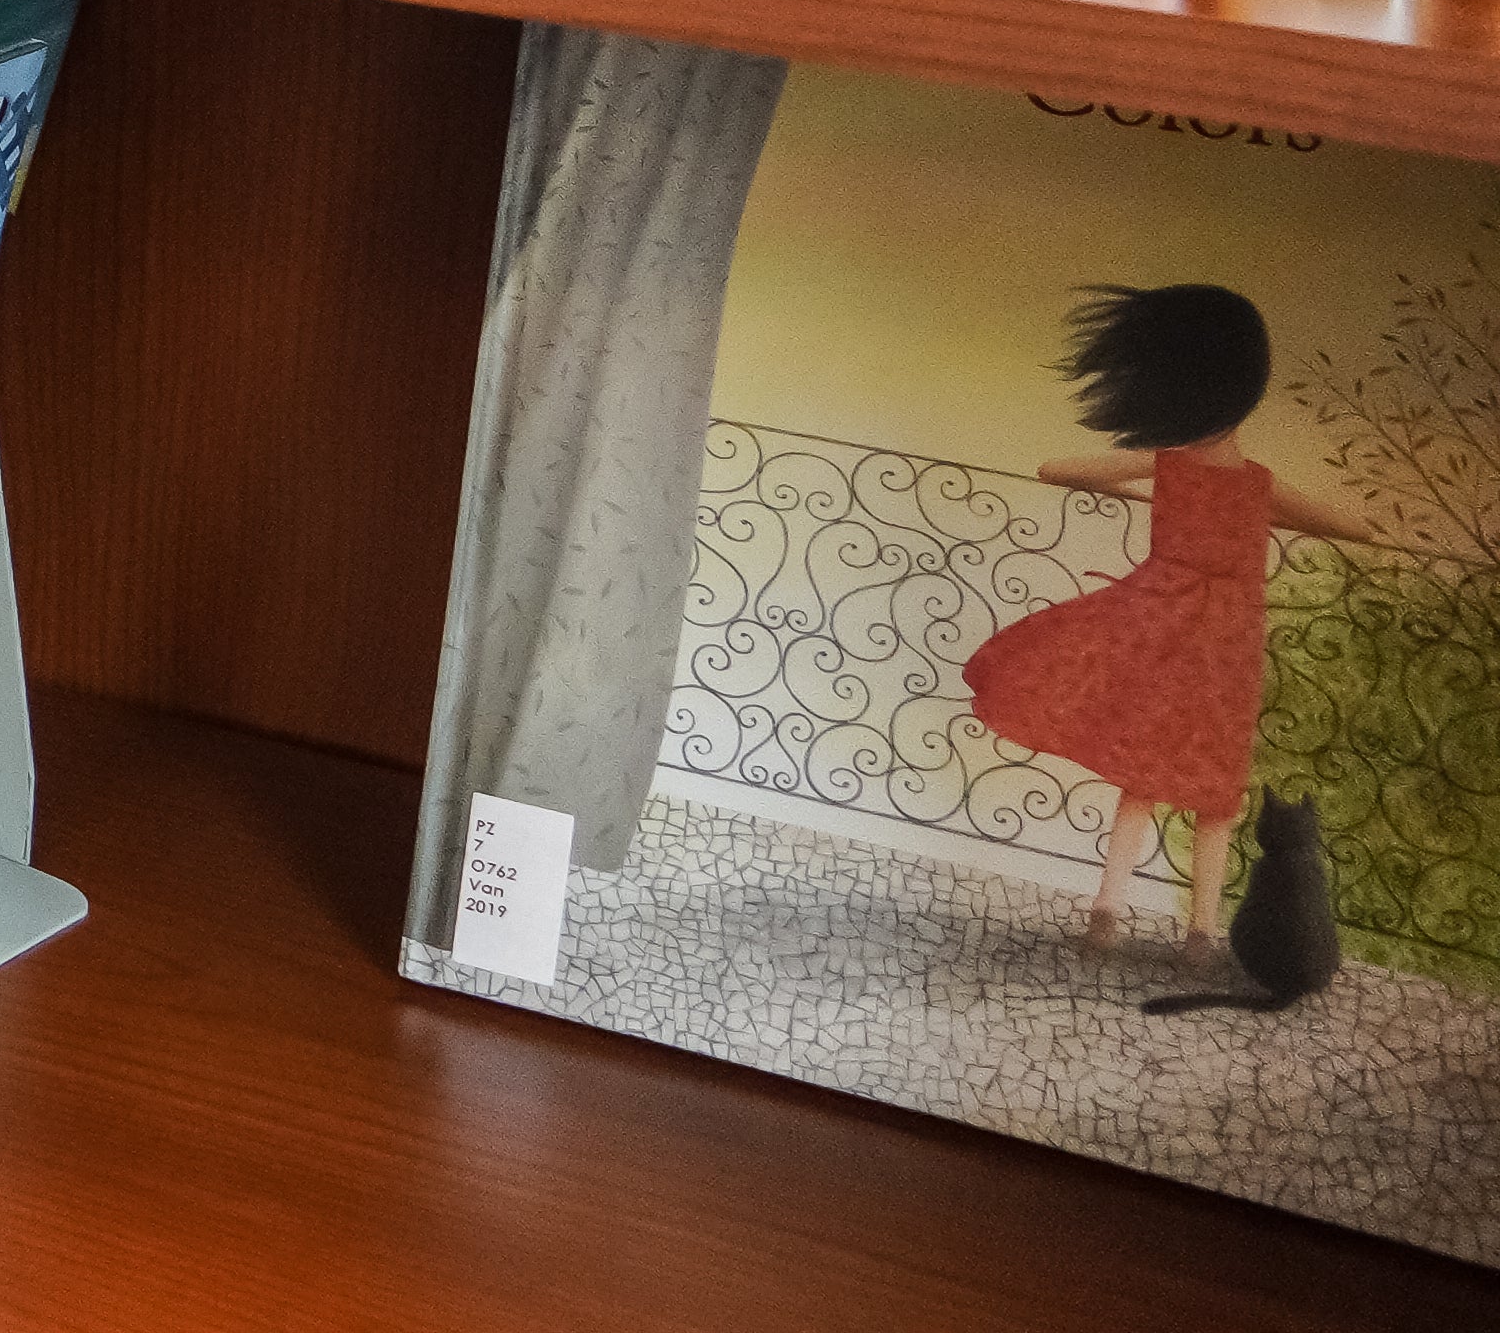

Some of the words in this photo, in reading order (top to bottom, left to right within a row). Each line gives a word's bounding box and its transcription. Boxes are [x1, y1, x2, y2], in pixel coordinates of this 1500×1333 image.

[476, 820, 495, 836] PZ
[469, 878, 504, 898] Van
[465, 898, 507, 918] 2019
